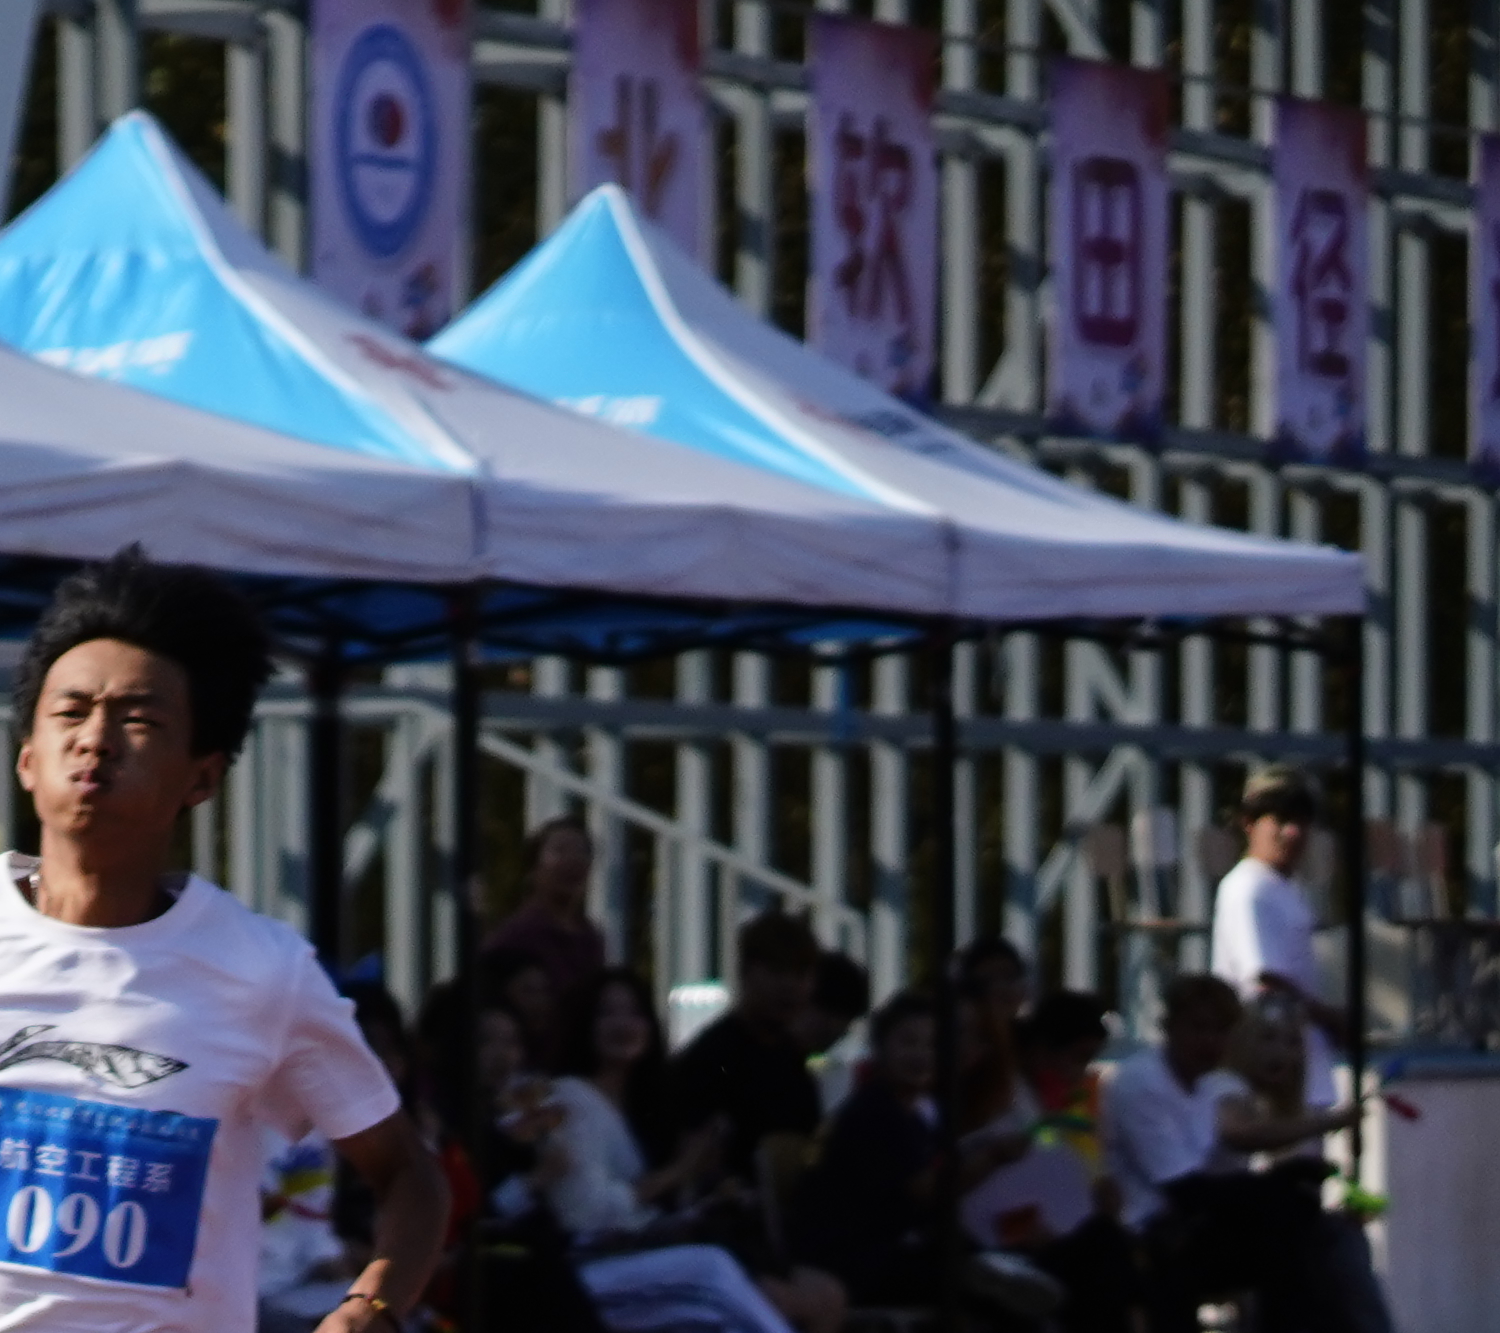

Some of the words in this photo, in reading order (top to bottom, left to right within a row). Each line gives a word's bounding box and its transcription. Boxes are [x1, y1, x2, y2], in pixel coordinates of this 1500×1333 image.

[1071, 154, 1144, 347] 田
[1290, 188, 1355, 382] 径
[6, 1184, 149, 1269] 090
